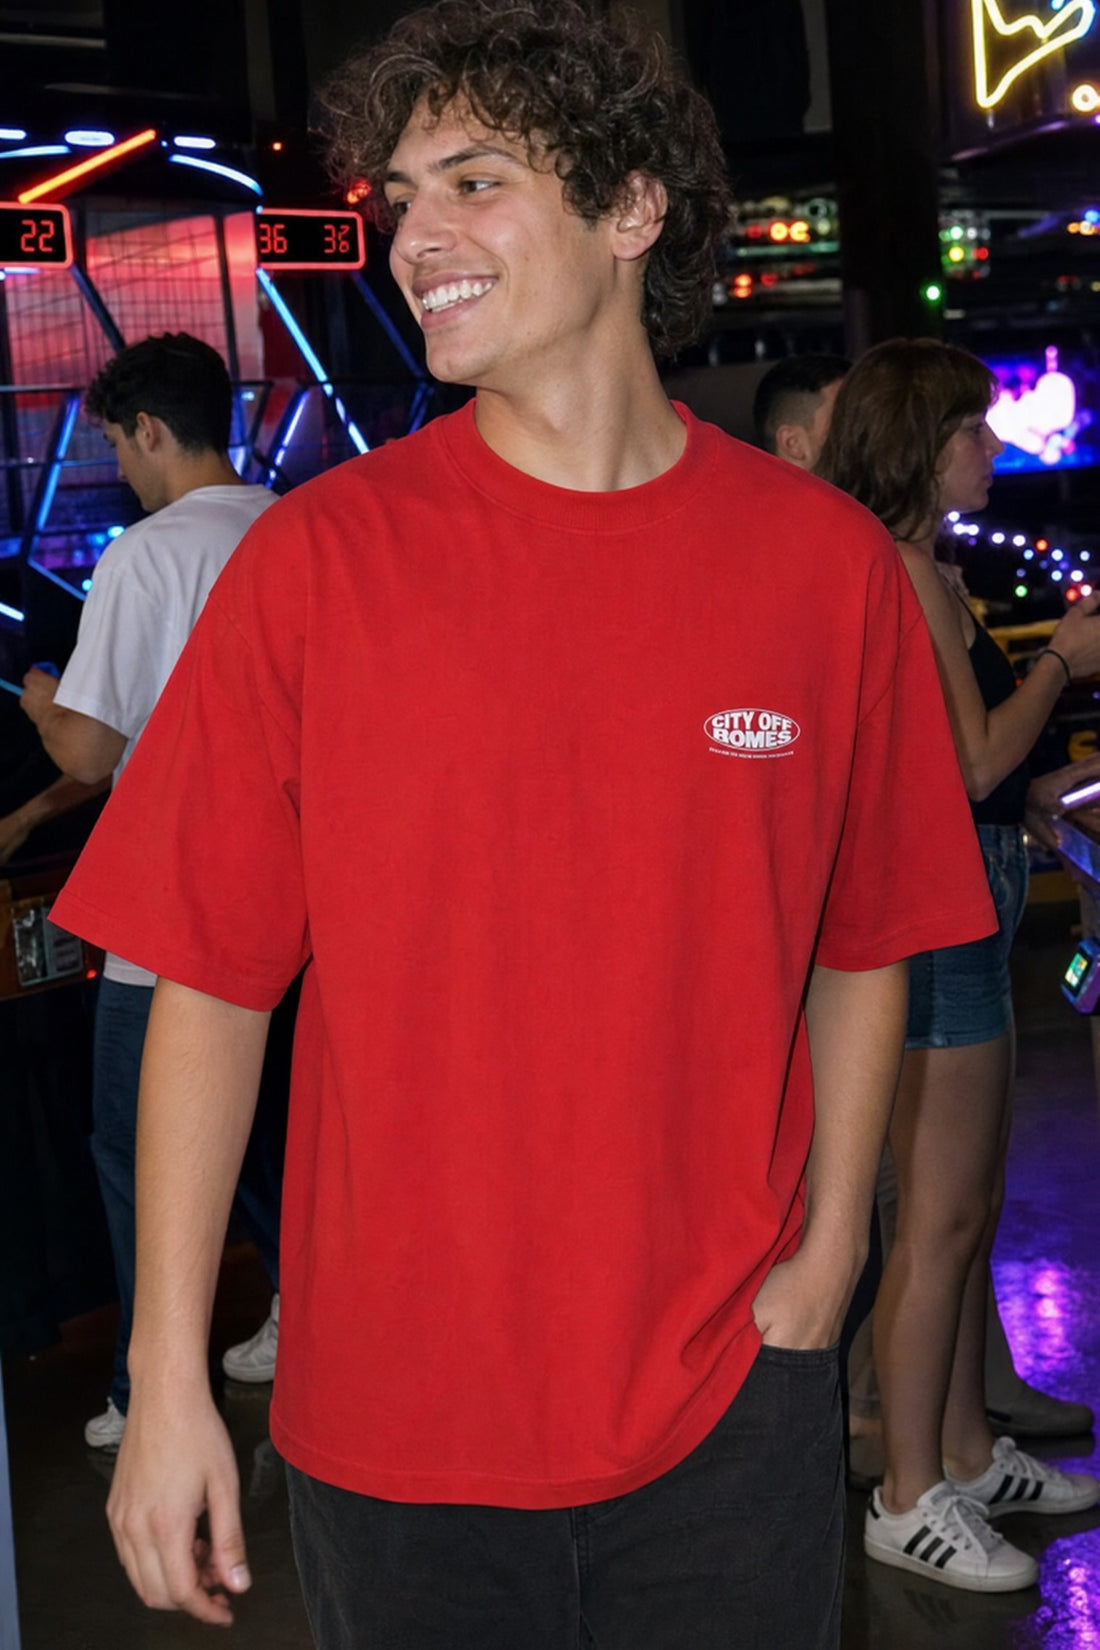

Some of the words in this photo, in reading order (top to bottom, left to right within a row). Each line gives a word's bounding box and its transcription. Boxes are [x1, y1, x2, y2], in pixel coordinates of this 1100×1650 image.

[21, 219, 54, 252] 22
[259, 223, 288, 253] 36
[711, 711, 755, 730] CITY
[758, 712, 792, 731] OFF
